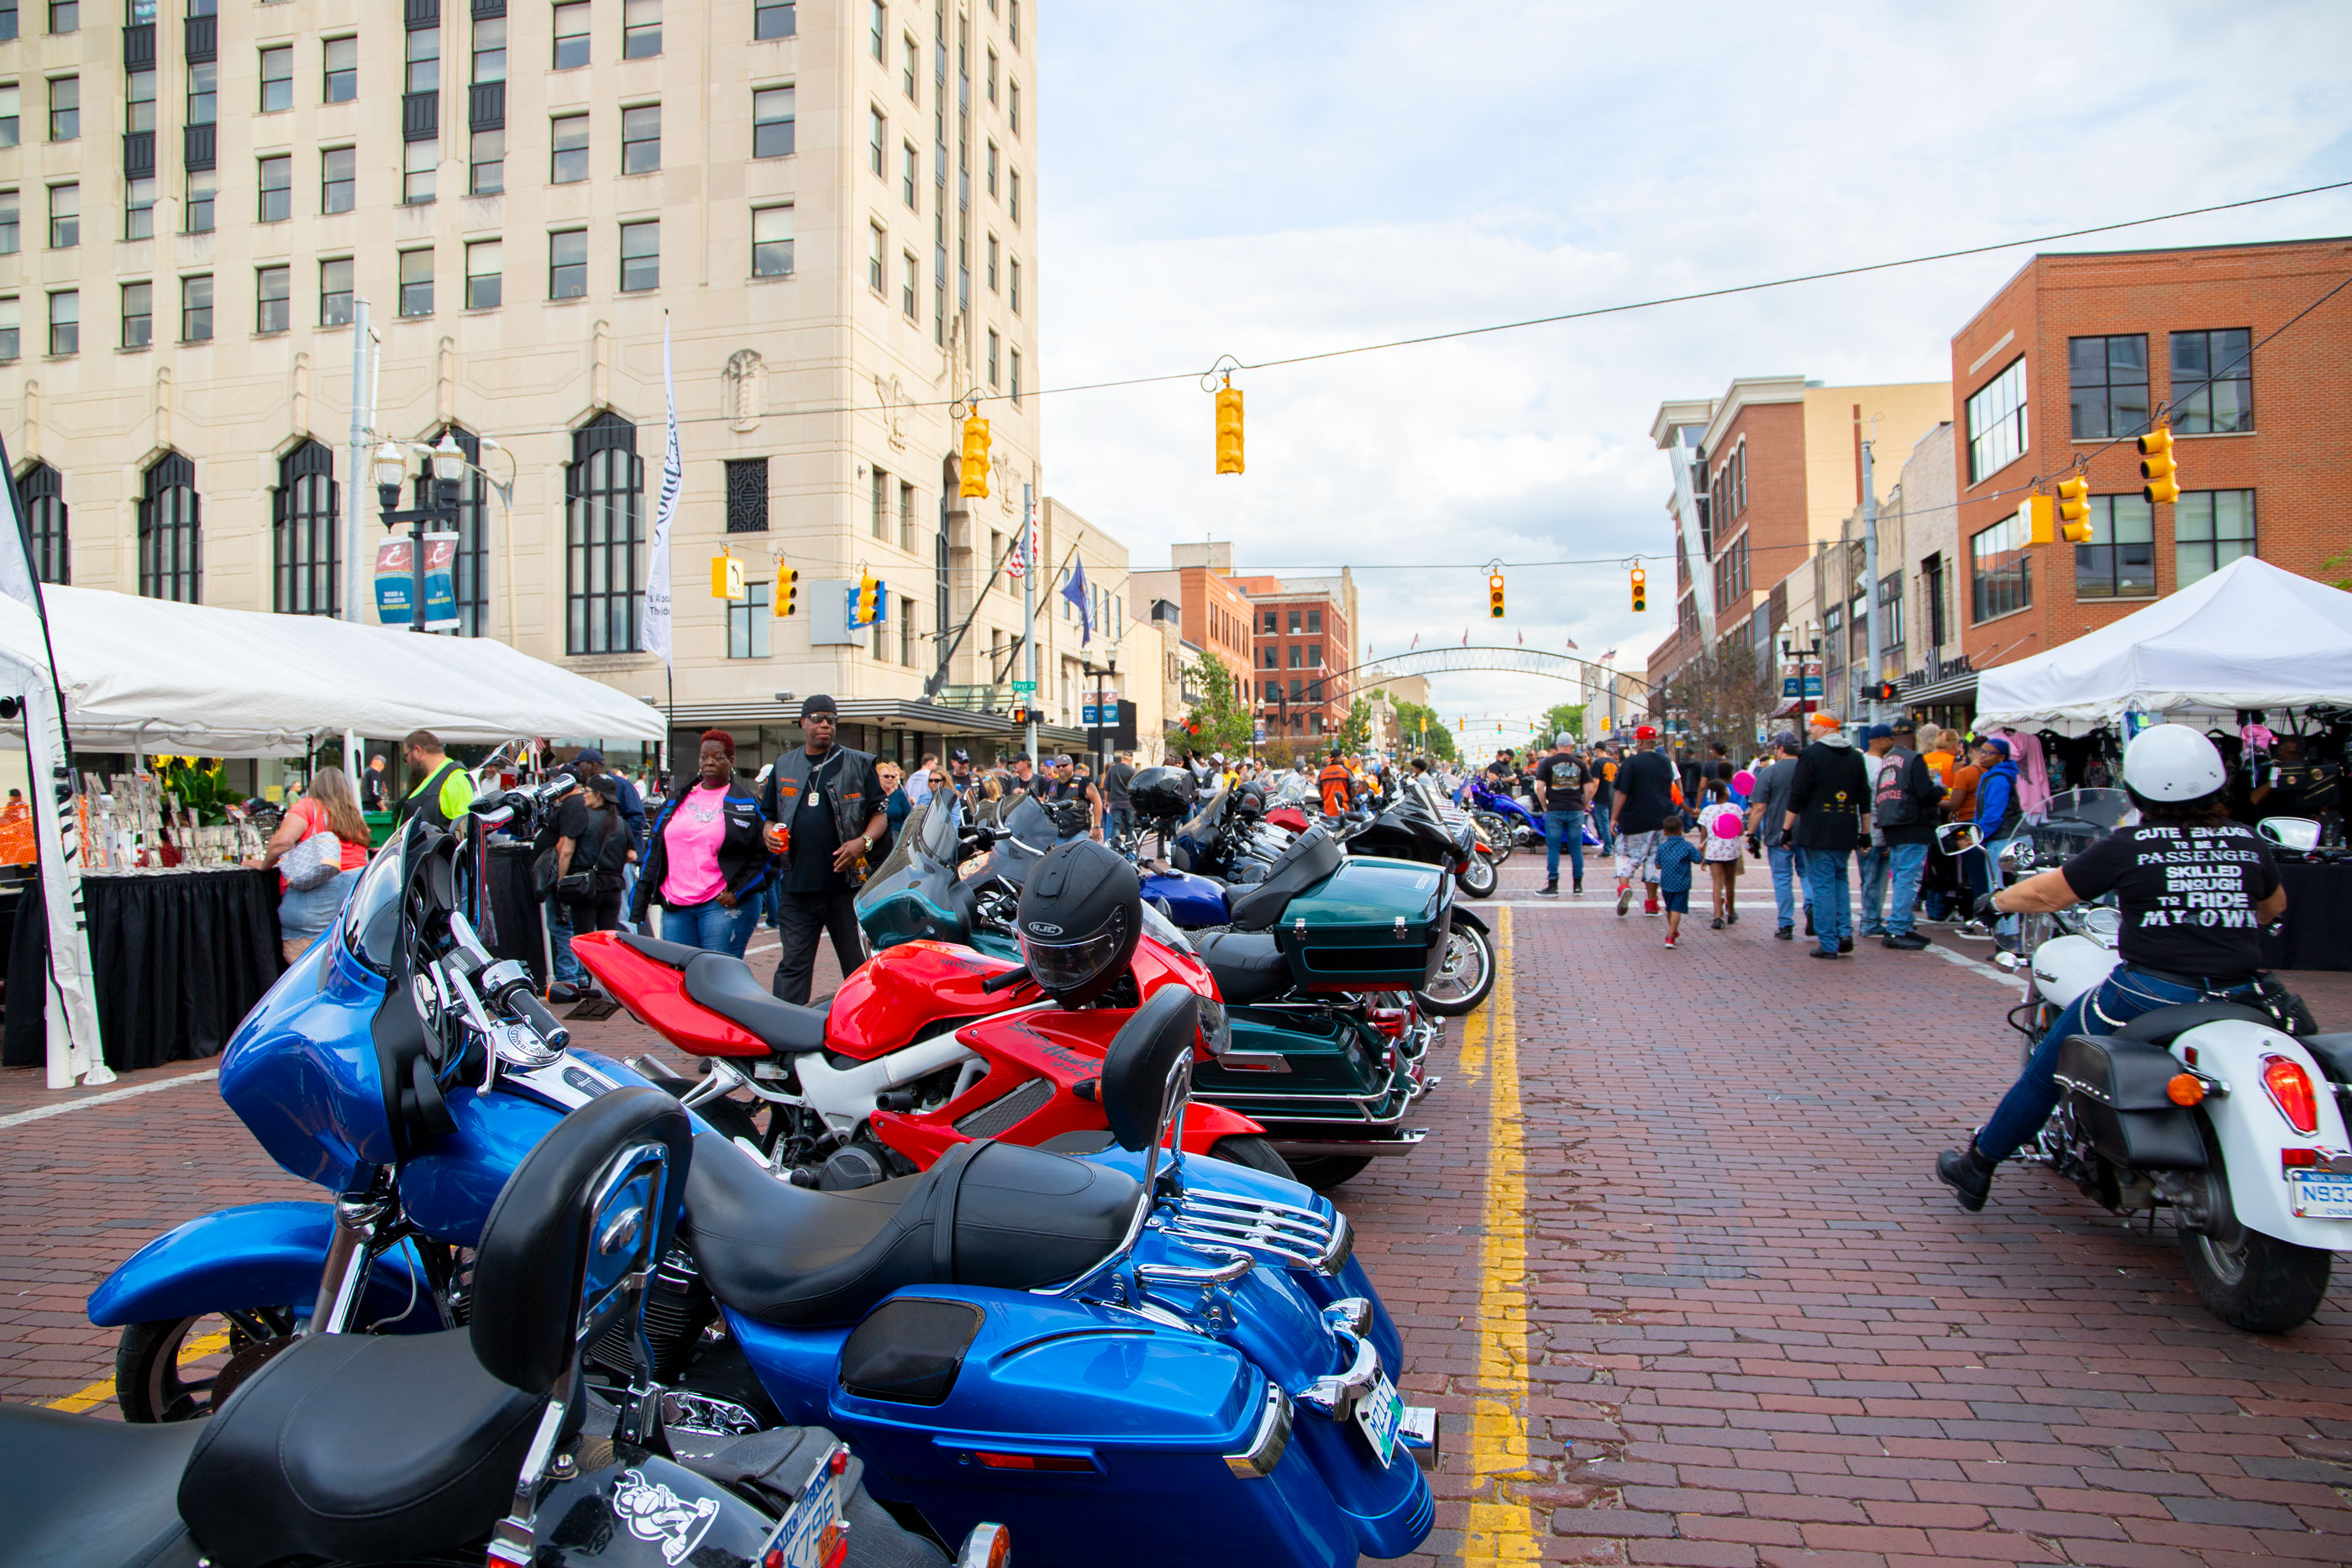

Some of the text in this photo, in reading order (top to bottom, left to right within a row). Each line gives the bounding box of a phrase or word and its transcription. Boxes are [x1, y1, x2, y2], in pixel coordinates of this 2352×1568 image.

[2134, 827, 2182, 840] CUTE
[2171, 840, 2229, 849] TO BE A
[2137, 850, 2260, 865] PASSENGER
[2166, 865, 2243, 878] SKILLED
[2166, 878, 2243, 892] ENOUGH
[2157, 892, 2249, 908] TO RIDE
[2139, 909, 2258, 928] MY OWN
[1032, 923, 1058, 935] HJC
[940, 958, 985, 977] HONDA
[1035, 1045, 1104, 1076] Hawk
[2307, 1173, 2352, 1183] MICHIG
[1370, 1377, 1393, 1440] MZ117
[1409, 1407, 1420, 1437] RINE
[777, 1471, 827, 1551] MICHIGAN
[783, 1487, 833, 1568] K796
[821, 1525, 833, 1555] DEC
